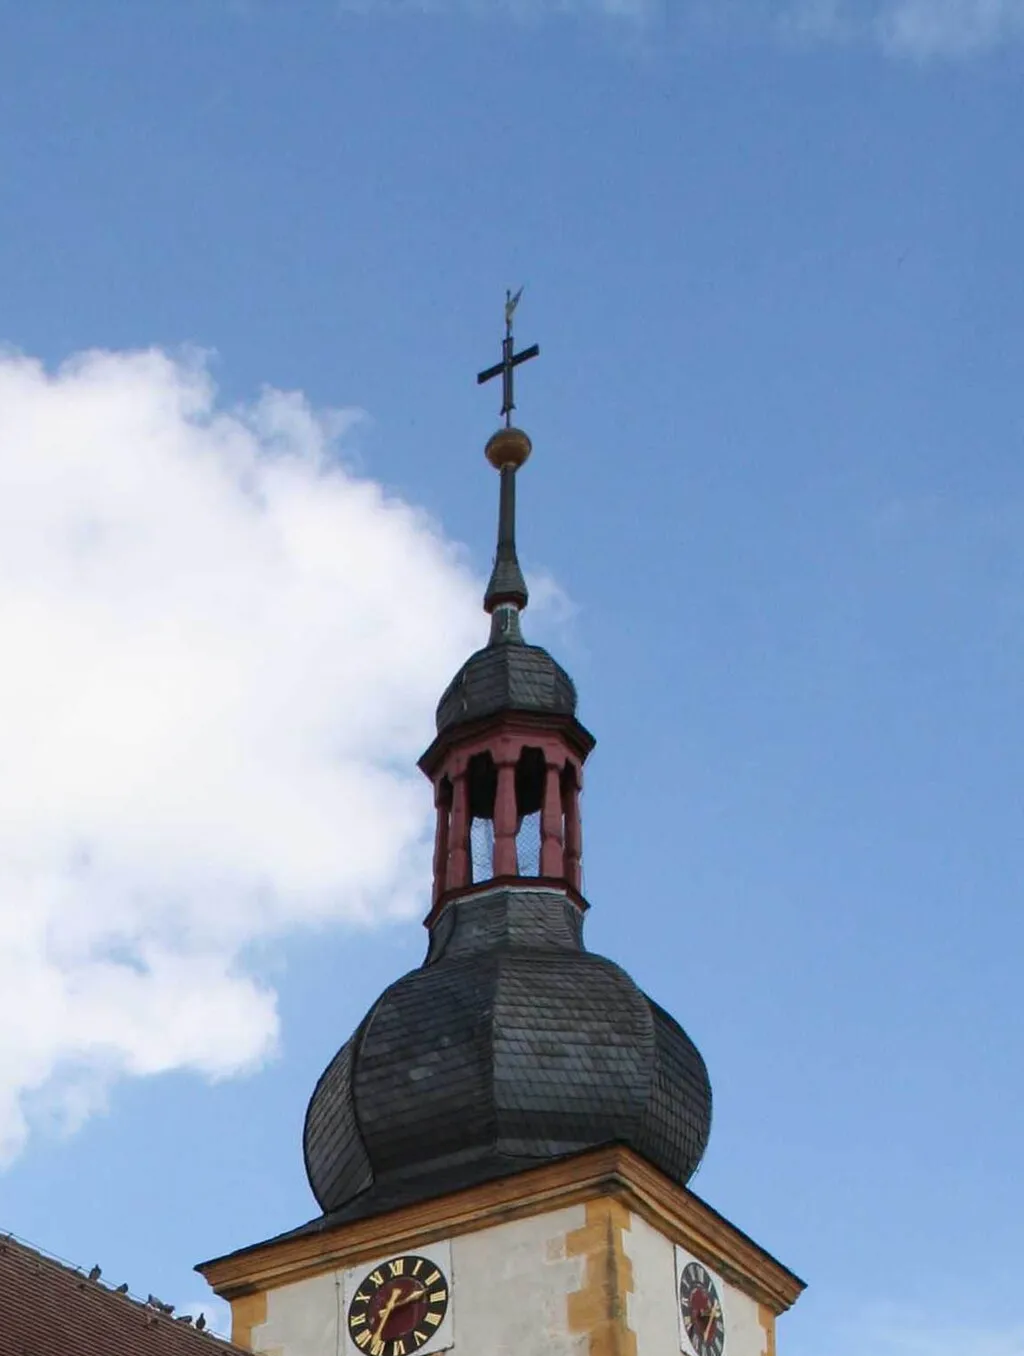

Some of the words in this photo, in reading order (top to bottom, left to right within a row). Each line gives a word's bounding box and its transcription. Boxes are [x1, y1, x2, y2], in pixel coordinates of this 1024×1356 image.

[388, 1259, 404, 1277] XII
[413, 1260, 424, 1275] I
[369, 1271, 384, 1287] XI
[424, 1270, 441, 1286] II
[355, 1291, 371, 1303] X
[430, 1289, 446, 1303] III
[351, 1313, 366, 1327] IX
[414, 1331, 428, 1346] V
[393, 1340, 406, 1356] VI
